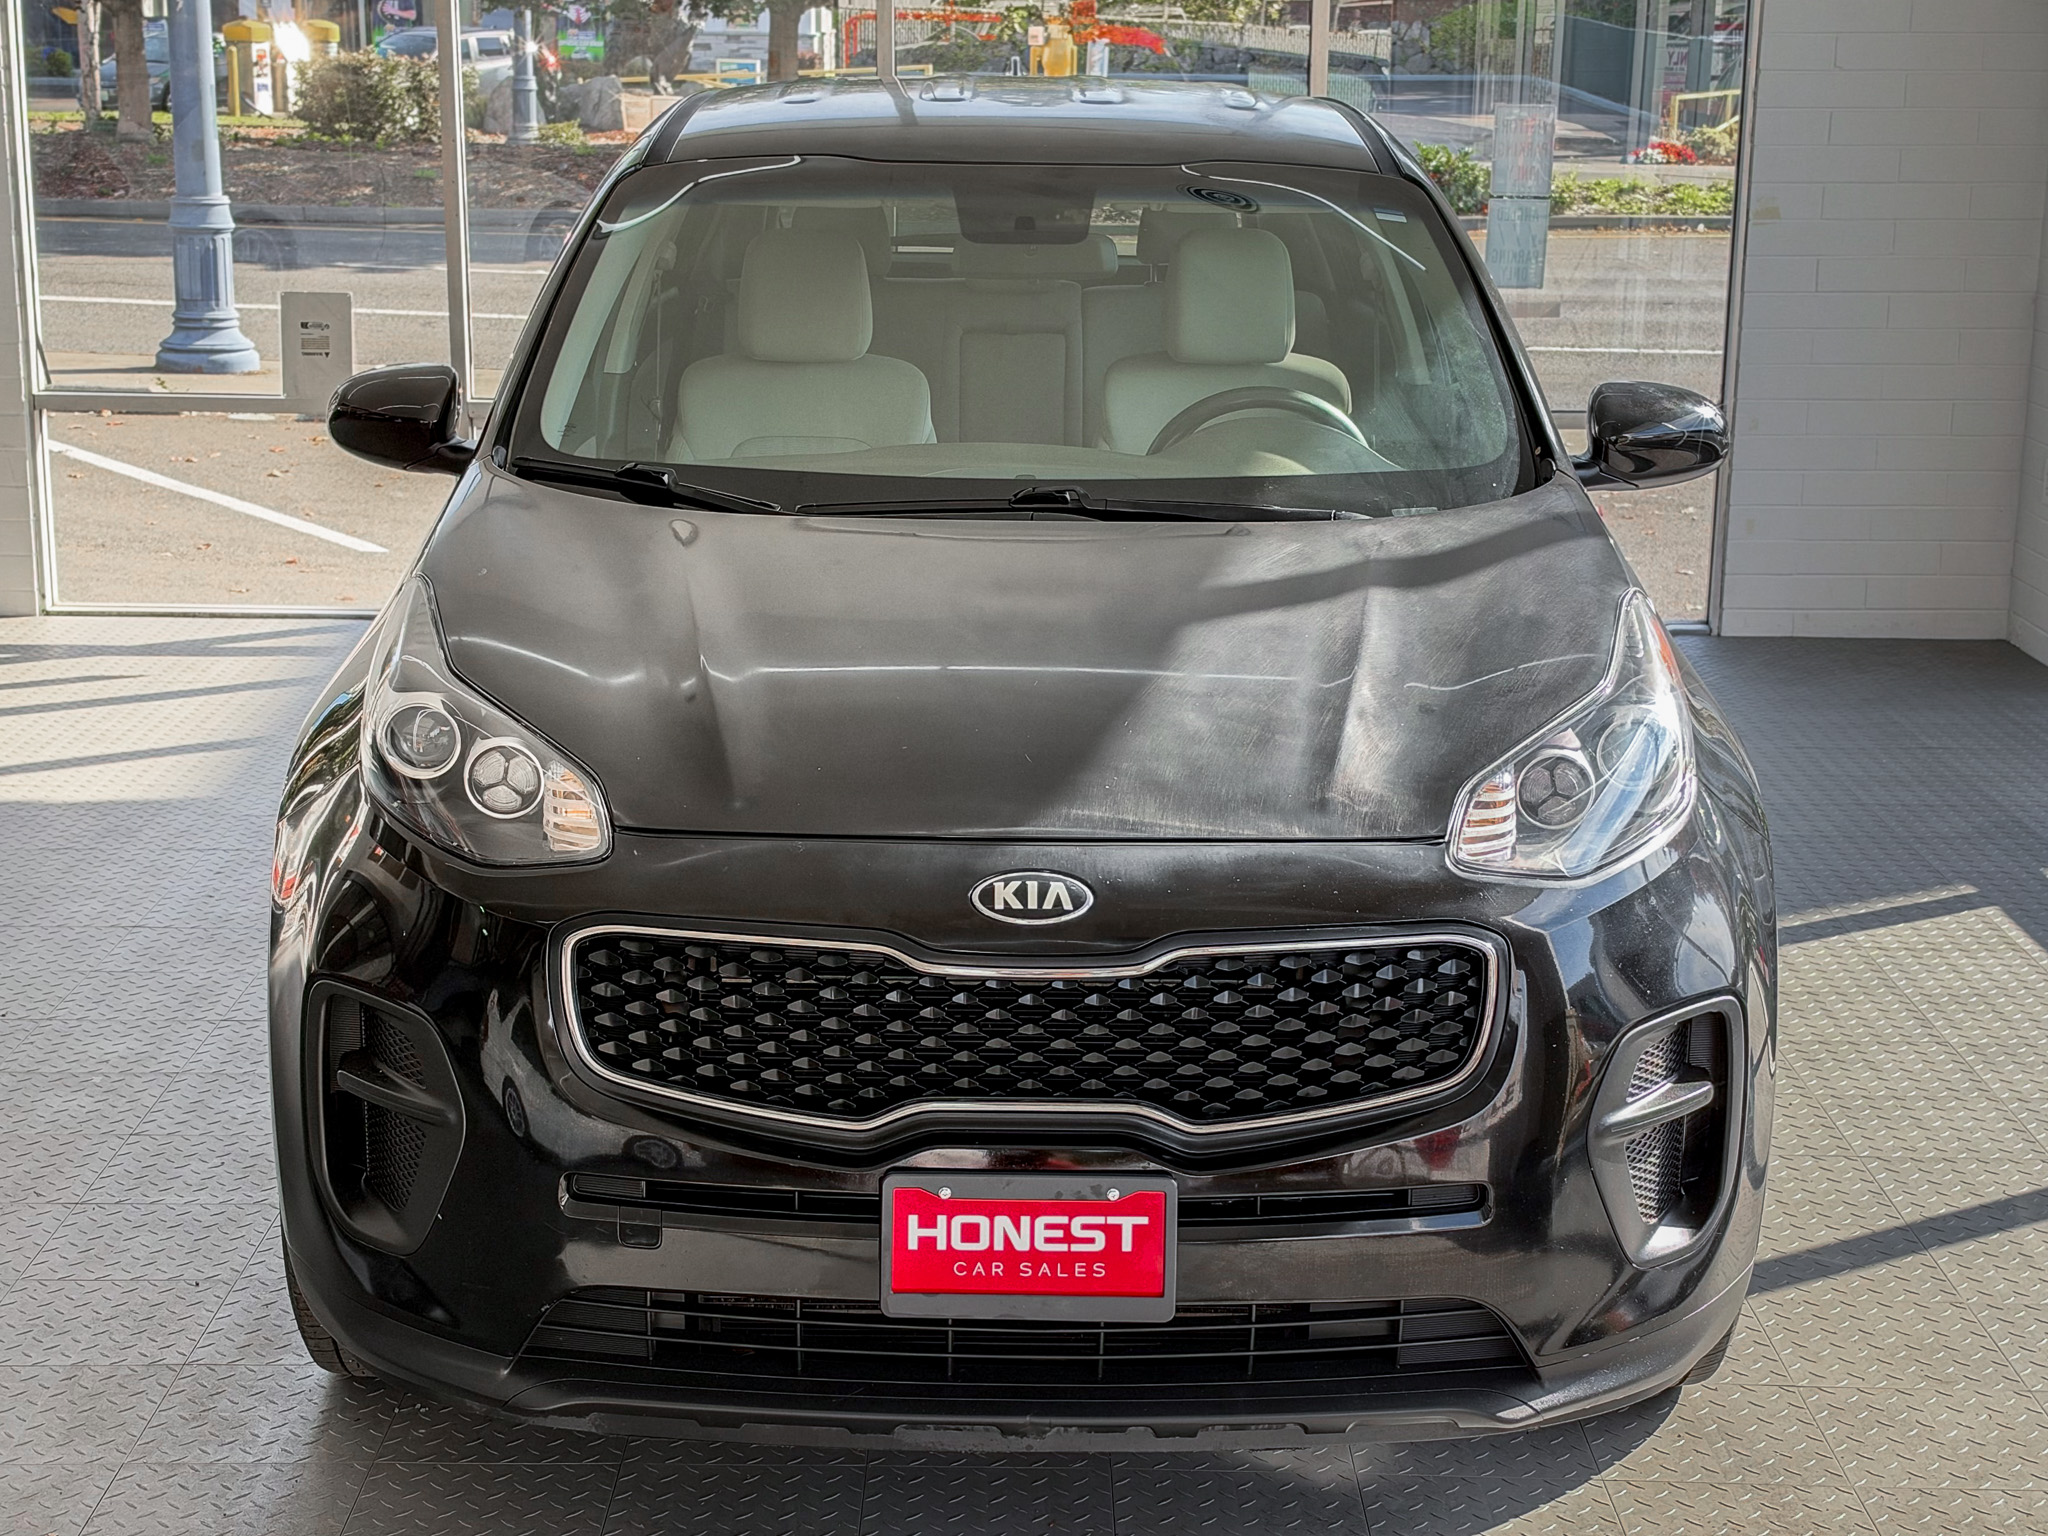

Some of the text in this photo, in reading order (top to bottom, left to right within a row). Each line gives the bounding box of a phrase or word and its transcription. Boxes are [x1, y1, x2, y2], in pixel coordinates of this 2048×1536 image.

[993, 881, 1074, 911] KIA
[907, 1214, 1149, 1252] HONEST
[953, 1261, 1106, 1277] CAR SALES
